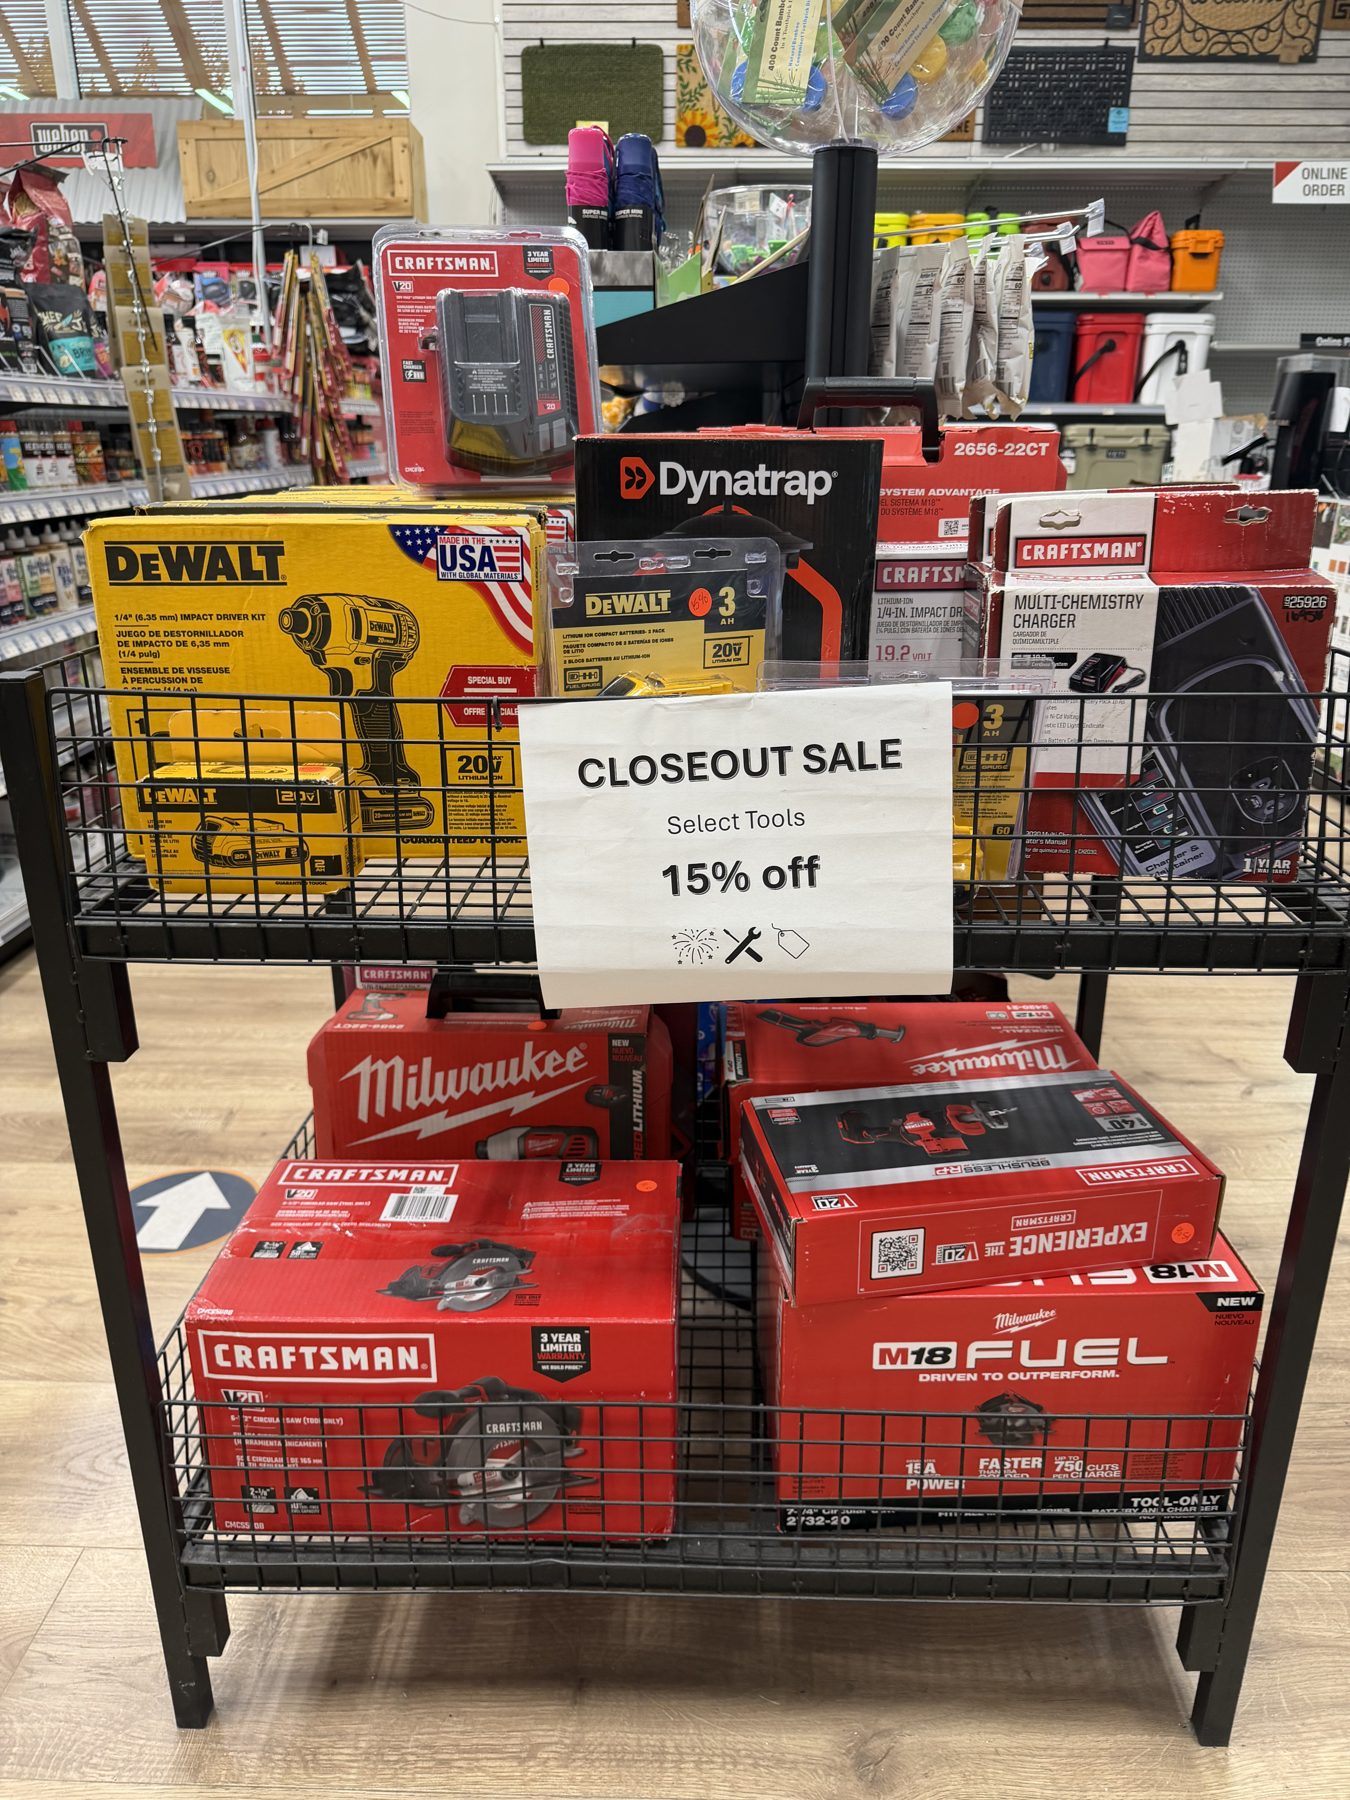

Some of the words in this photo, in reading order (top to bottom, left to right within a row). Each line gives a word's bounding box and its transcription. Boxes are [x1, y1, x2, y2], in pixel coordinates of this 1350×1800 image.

[771, 27, 782, 54] Count
[1302, 167, 1348, 181] ONLINE
[1303, 184, 1346, 197] ORDER
[395, 257, 491, 271] CRAFTSMAN
[544, 309, 554, 359] CRAFTSMAN
[954, 442, 1050, 457] 2656-22CT
[660, 461, 833, 504] Dynatrap
[879, 488, 925, 497] SYSTEM
[928, 488, 1001, 497] ADVANTAGE
[890, 499, 919, 507] SISTEMA
[439, 545, 497, 572] USA
[1022, 542, 1137, 561] CRAFTSMAN
[483, 572, 519, 580] MATERIALS
[718, 586, 736, 617] 3
[1014, 594, 1145, 610] MULTI-CHEMISTRY
[135, 613, 157, 622] (6.35
[159, 613, 178, 622] mm)
[180, 613, 214, 621] IMPACT
[216, 613, 249, 621] DRIVER
[252, 613, 266, 621] KIT
[877, 607, 908, 619] 1/4-IN.
[910, 607, 948, 618] IMPACT
[1013, 613, 1076, 629] CHARGER
[116, 630, 146, 638] JUEGO
[149, 630, 161, 638] DE
[164, 630, 244, 638] DESTORNILLADOR
[117, 640, 129, 648] DE
[132, 640, 173, 648] IMPACTO
[176, 640, 188, 648] DE
[139, 650, 160, 660] pulg)
[876, 645, 911, 662] 19.2
[120, 667, 168, 675] ENSEMBLE
[172, 667, 184, 675] DE
[186, 667, 230, 675] VISSEUSE
[131, 676, 187, 684] PERCUSSION
[190, 676, 203, 684] DE
[468, 676, 497, 685] SPECIAL
[498, 676, 511, 685] BUY
[464, 707, 486, 716] OFFRE
[983, 704, 1005, 730] 3
[578, 745, 793, 789] CLOSEOUT
[803, 738, 903, 774] SALE
[667, 813, 740, 835] Select
[745, 808, 806, 830] Tools
[996, 826, 1010, 835] 60
[662, 860, 750, 896] 15%
[762, 855, 820, 889] off
[364, 970, 427, 980] CRAFTSMAN
[910, 1043, 1082, 1077] Milwaukee
[339, 1040, 588, 1124] Milwaukee
[964, 1159, 1050, 1174] BRUSHLESS
[1087, 1161, 1188, 1182] CRAFTSMAN
[293, 1167, 442, 1182] CRAFTSMAN
[1014, 1213, 1072, 1227] CRAFTSMAN
[985, 1246, 1005, 1257] THE
[1009, 1222, 1148, 1257] EXPERIENCE
[1151, 1263, 1229, 1280] M18
[1217, 1297, 1255, 1307] NEW
[993, 1309, 1057, 1329] Milwaukee
[540, 1333, 548, 1342] 3
[551, 1333, 581, 1342] YEAR
[540, 1343, 581, 1352] LIMITED
[878, 1347, 952, 1366] M18
[966, 1337, 1168, 1369] FUEL
[213, 1343, 419, 1371] CRAFTSMAN
[919, 1373, 977, 1382] DRIVEN
[982, 1373, 1004, 1381] TO
[1008, 1370, 1120, 1381] OUTPERFORM.
[486, 1421, 542, 1434] CRAFTSMAN
